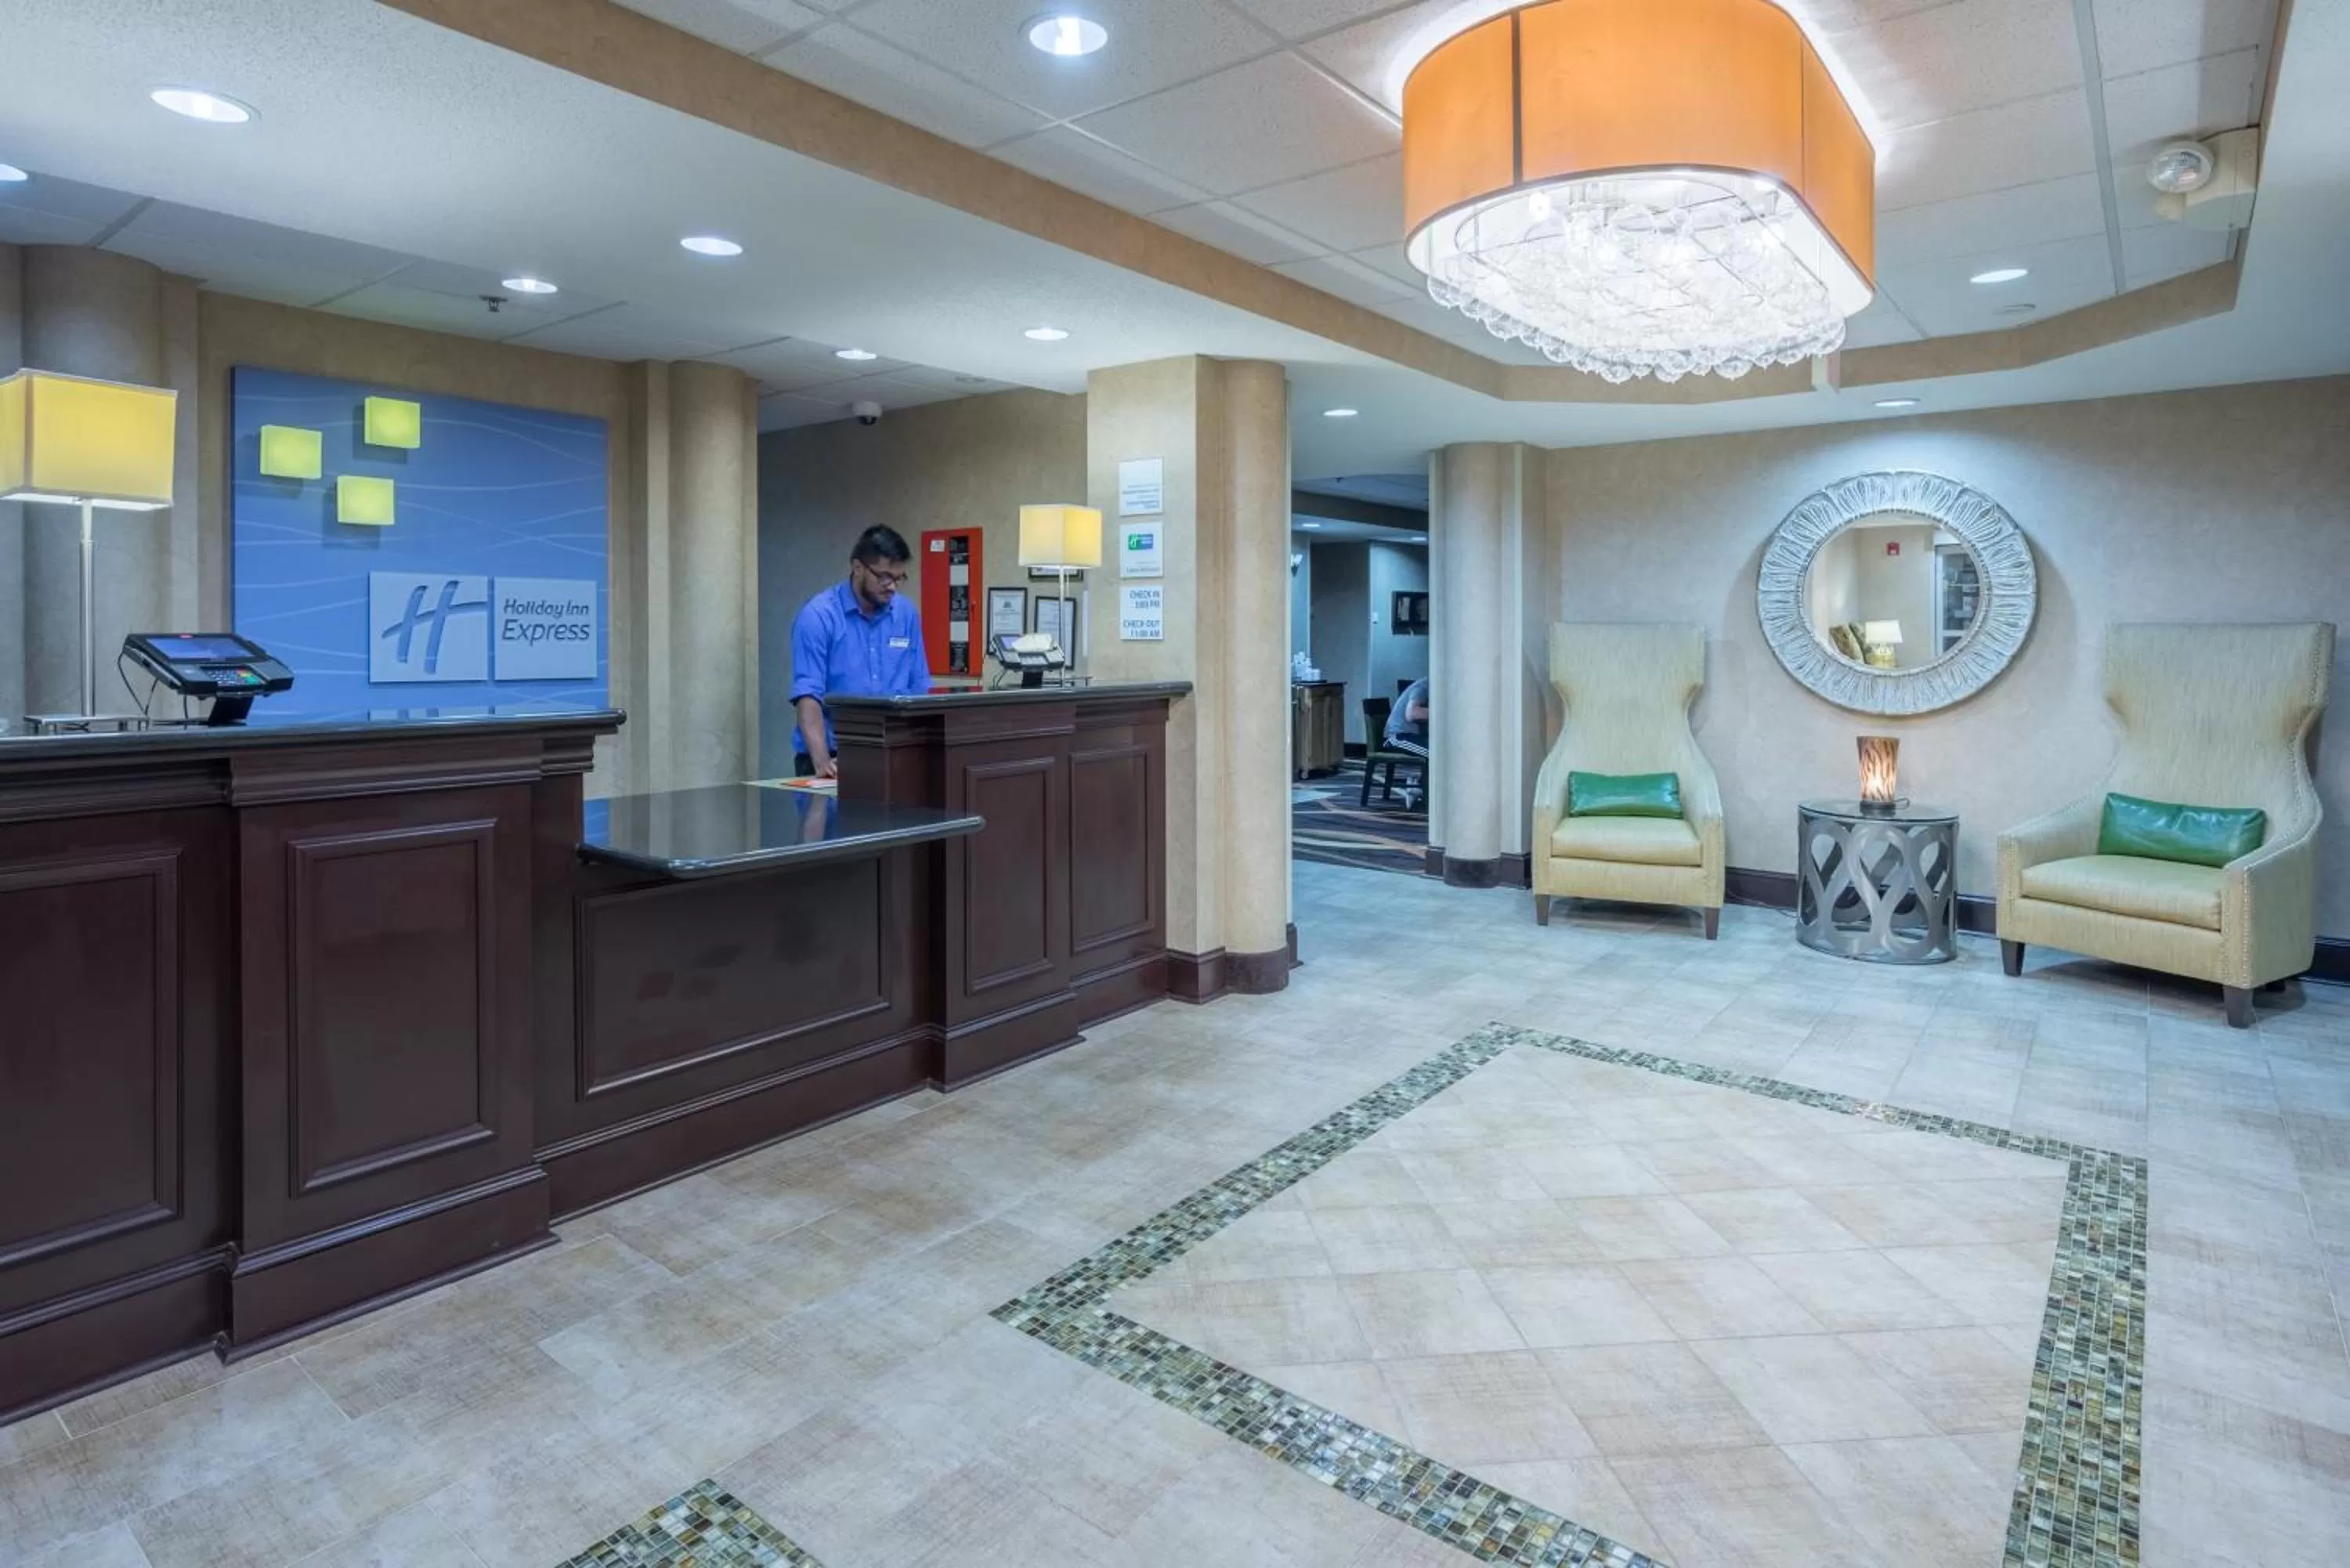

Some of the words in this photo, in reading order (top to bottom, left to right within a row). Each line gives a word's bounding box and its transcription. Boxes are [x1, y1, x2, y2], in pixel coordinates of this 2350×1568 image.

[1129, 590, 1151, 598] CHECK
[503, 598, 564, 619] Holiday
[566, 599, 590, 615] Inn
[501, 618, 591, 647] Express
